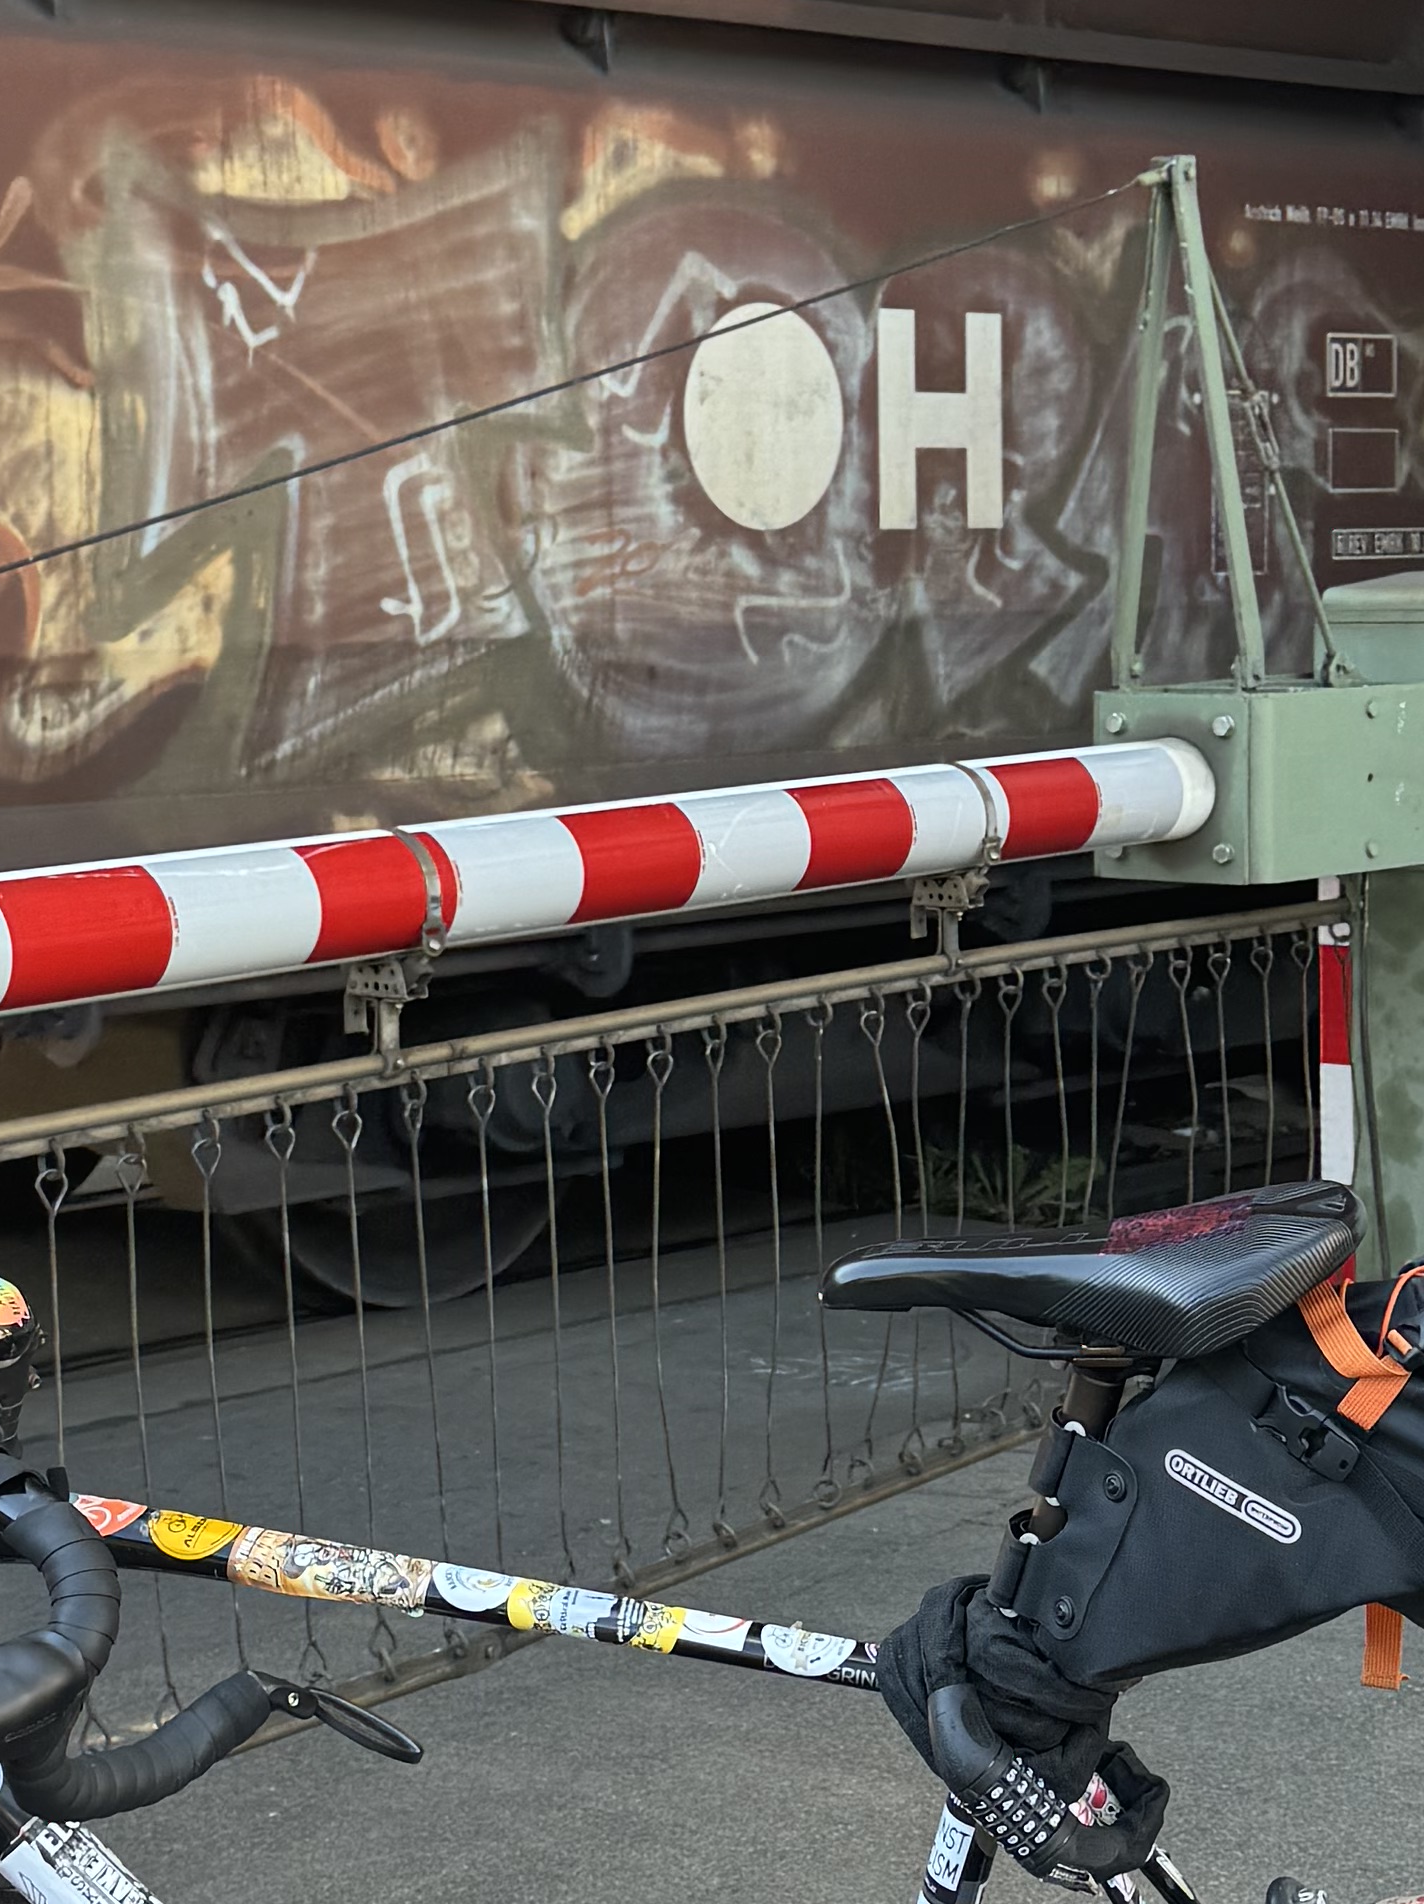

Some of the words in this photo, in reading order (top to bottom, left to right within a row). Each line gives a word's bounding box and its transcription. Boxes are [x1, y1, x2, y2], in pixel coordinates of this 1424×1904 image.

[1330, 342, 1360, 389] DB
[1170, 1455, 1239, 1506] ORTLIEB
[826, 1666, 878, 1688] GRIN
[930, 1849, 960, 1886] ISM
